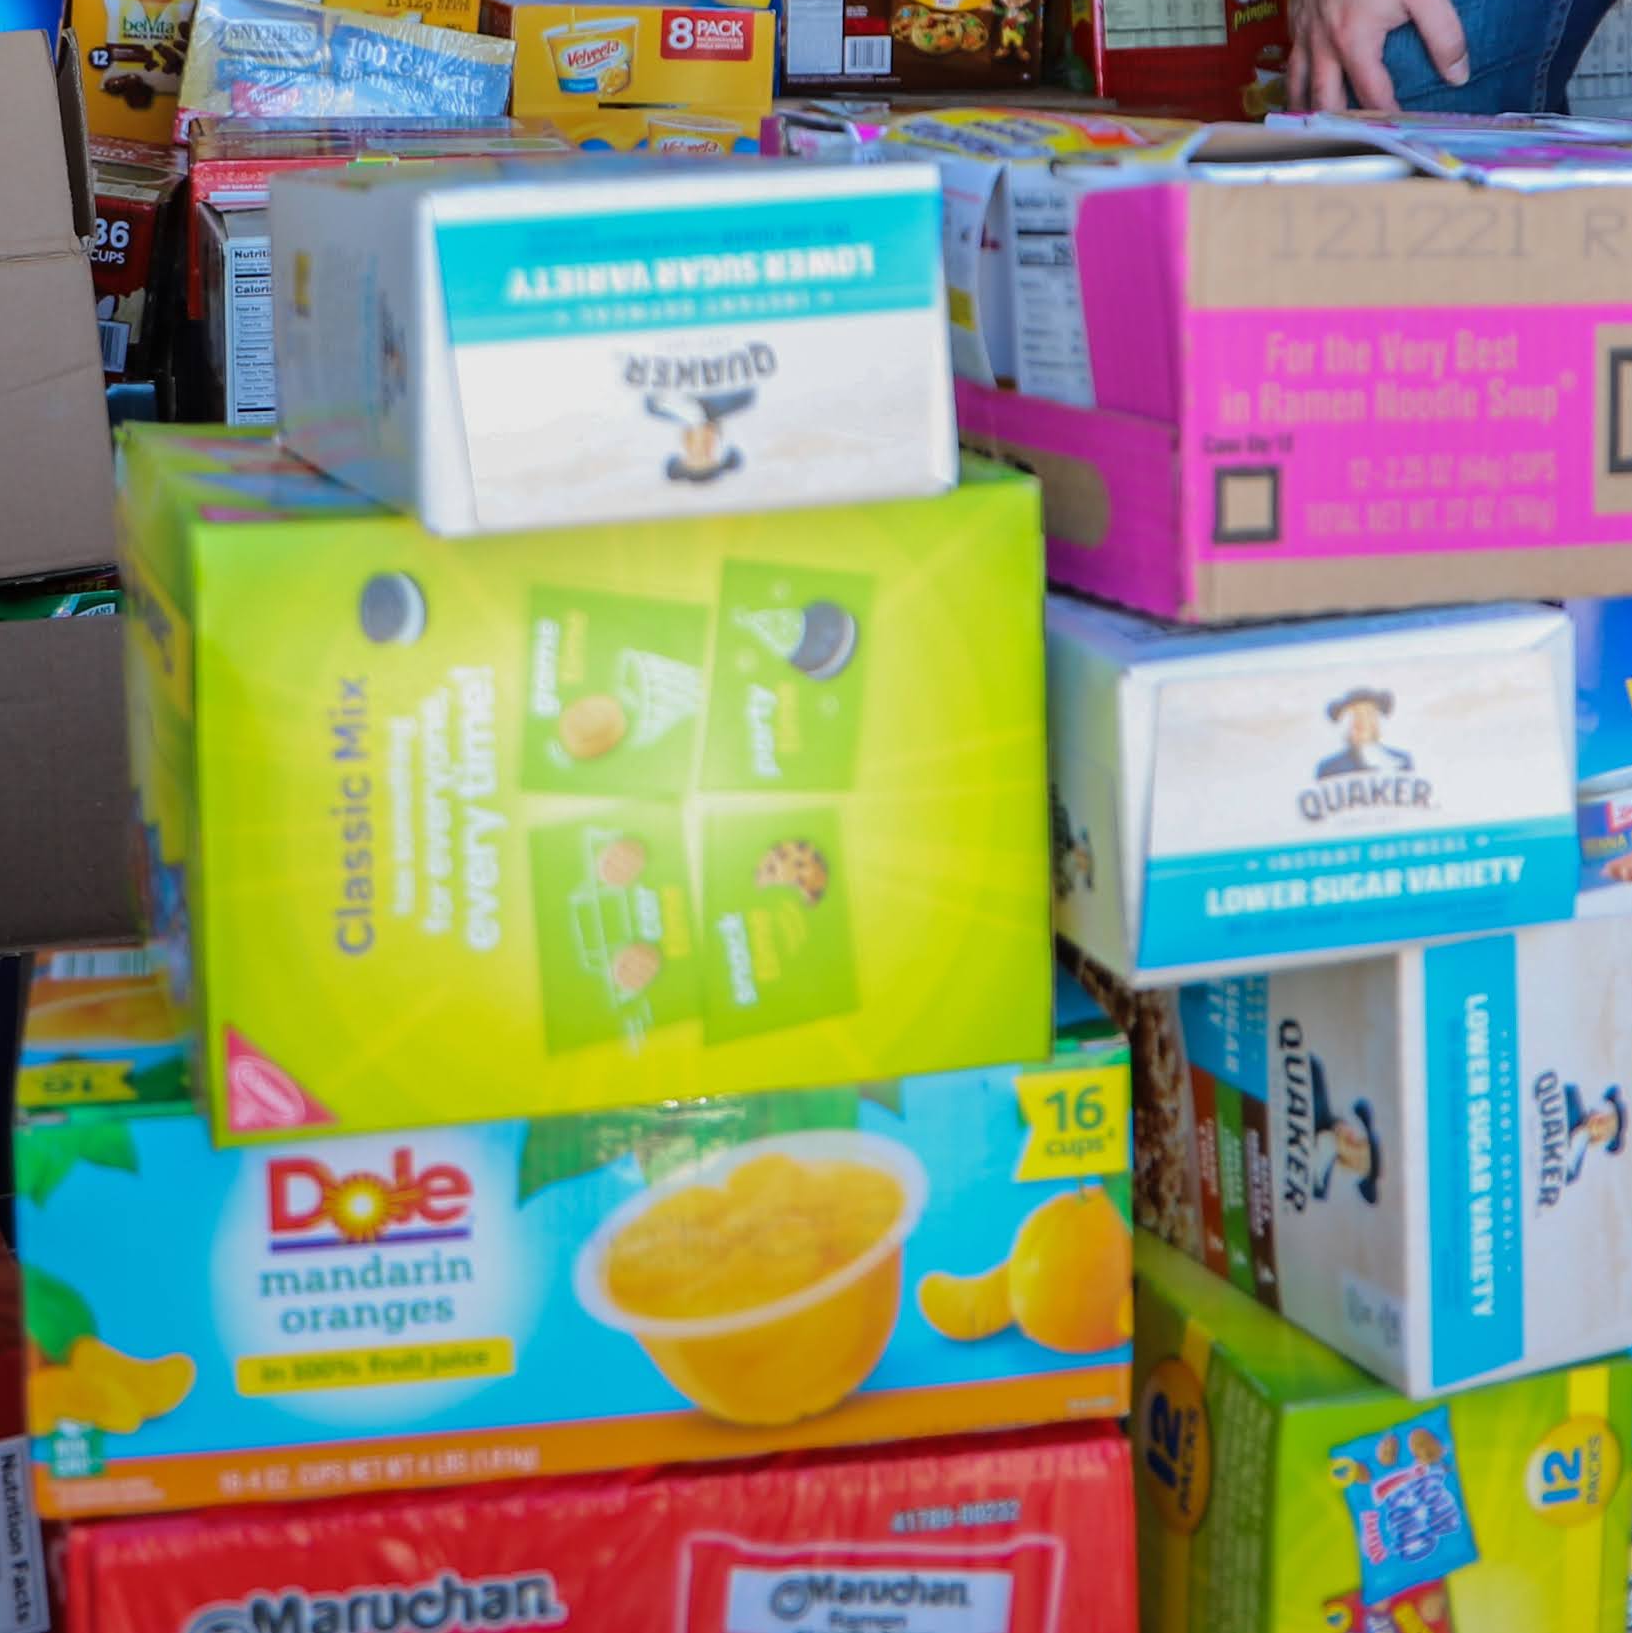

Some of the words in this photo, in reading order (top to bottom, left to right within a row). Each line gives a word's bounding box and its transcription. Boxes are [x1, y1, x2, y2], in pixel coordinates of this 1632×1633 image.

[122, 15, 175, 34] belVita
[669, 17, 694, 50] 8
[697, 20, 744, 36] PACK
[93, 50, 108, 67] 12
[347, 36, 387, 67] 100
[567, 40, 620, 67] Velveeta
[508, 259, 650, 303] VARIETY
[655, 250, 759, 291] SUGAR
[766, 244, 875, 283] LOWER
[623, 342, 779, 389] QUAKER
[1268, 332, 1316, 373] For
[1325, 332, 1372, 373] the
[1378, 331, 1447, 380] Very
[1456, 329, 1518, 370] Best
[329, 675, 367, 762] Mix
[1299, 777, 1434, 822] QUAKER
[333, 773, 375, 957] Classic
[1206, 879, 1307, 918] LOWER
[1311, 869, 1403, 905] SUGAR
[1408, 856, 1526, 894] VARIETY
[1464, 992, 1491, 1095] LOWER
[1045, 1085, 1106, 1133] 16
[1278, 1018, 1308, 1215] QUAKER
[1467, 1097, 1494, 1193] SUGAR
[1533, 1070, 1565, 1209] QUAKER
[266, 1147, 474, 1236] Dole
[260, 1250, 474, 1297] mandarin
[1470, 1194, 1497, 1319] VARIETY
[280, 1292, 454, 1335] oranges
[1146, 1391, 1187, 1488] 12
[1542, 1446, 1583, 1506] 12
[0, 1453, 24, 1555] Nutrition
[11, 1559, 30, 1624] Facts
[249, 1574, 559, 1633] Maruchan
[809, 1576, 969, 1610] Maruchan
